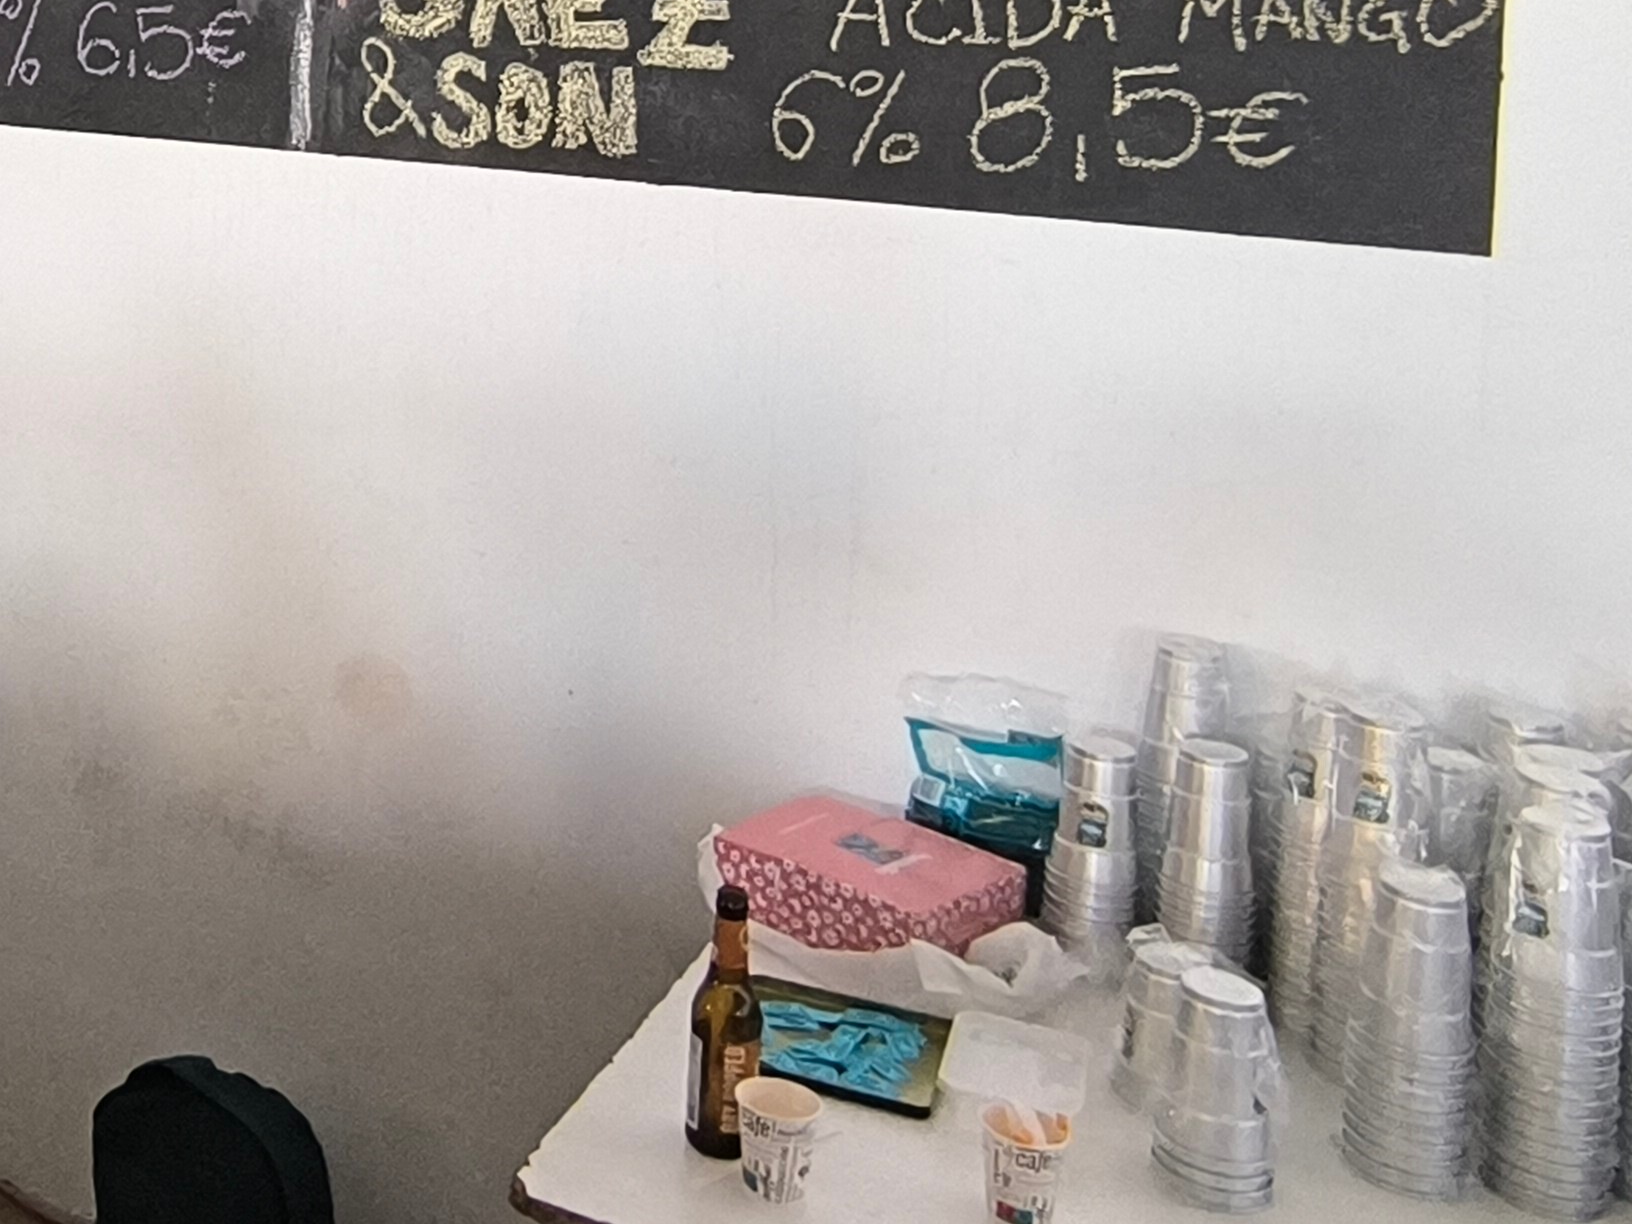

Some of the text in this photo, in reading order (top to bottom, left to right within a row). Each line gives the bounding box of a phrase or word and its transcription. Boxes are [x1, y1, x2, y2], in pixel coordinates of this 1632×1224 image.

[75, 1, 252, 81] 6,5€
[770, 69, 922, 168] 6%
[969, 56, 1311, 184] 8,5€
